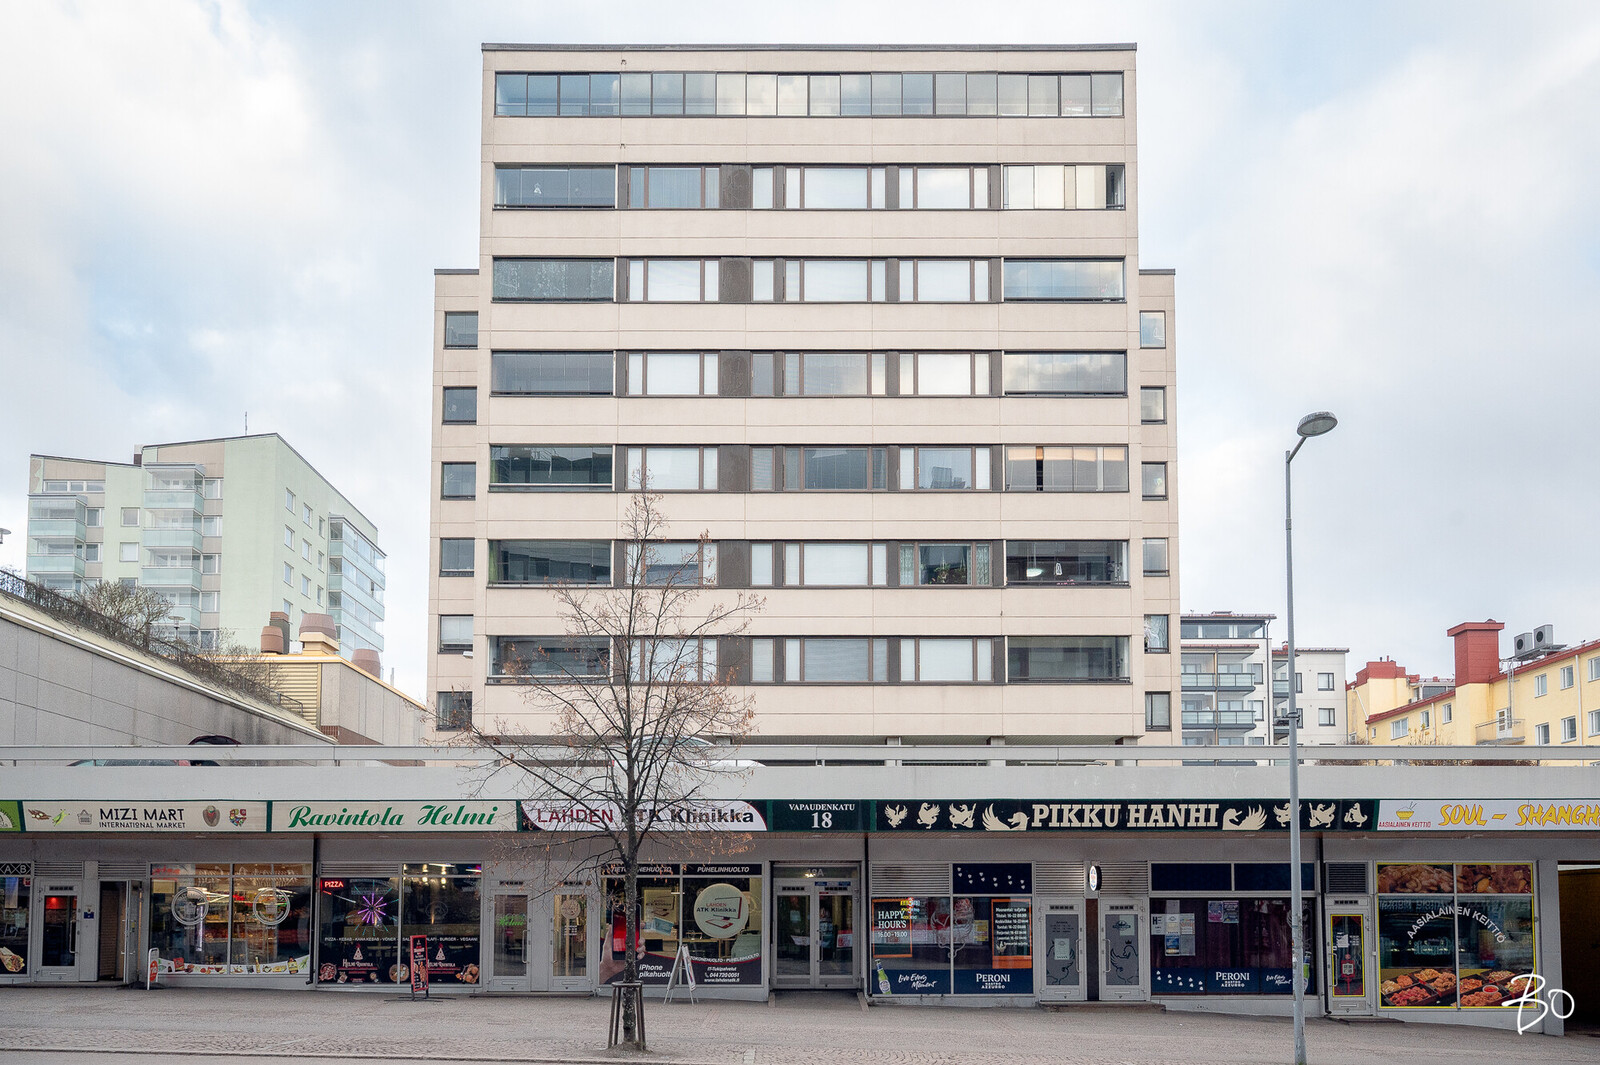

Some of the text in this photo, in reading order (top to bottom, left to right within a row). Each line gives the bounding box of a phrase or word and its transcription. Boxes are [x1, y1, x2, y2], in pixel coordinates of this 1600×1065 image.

[100, 808, 184, 820] MIZI MART
[288, 805, 499, 828] Ravintola Helmi
[537, 809, 613, 822] LAHDEN
[670, 809, 754, 823] Klinikka
[812, 812, 832, 828] 18
[1031, 804, 1220, 828] PIKKU HANHI
[1438, 804, 1488, 826] SOUL
[1515, 804, 1600, 826] SHANGH
[878, 910, 905, 920] HAPPY
[1407, 906, 1507, 943] AASIALAINEN KEITTIÖ
[976, 973, 1010, 982] PERONI
[1216, 972, 1250, 980] PERONI
